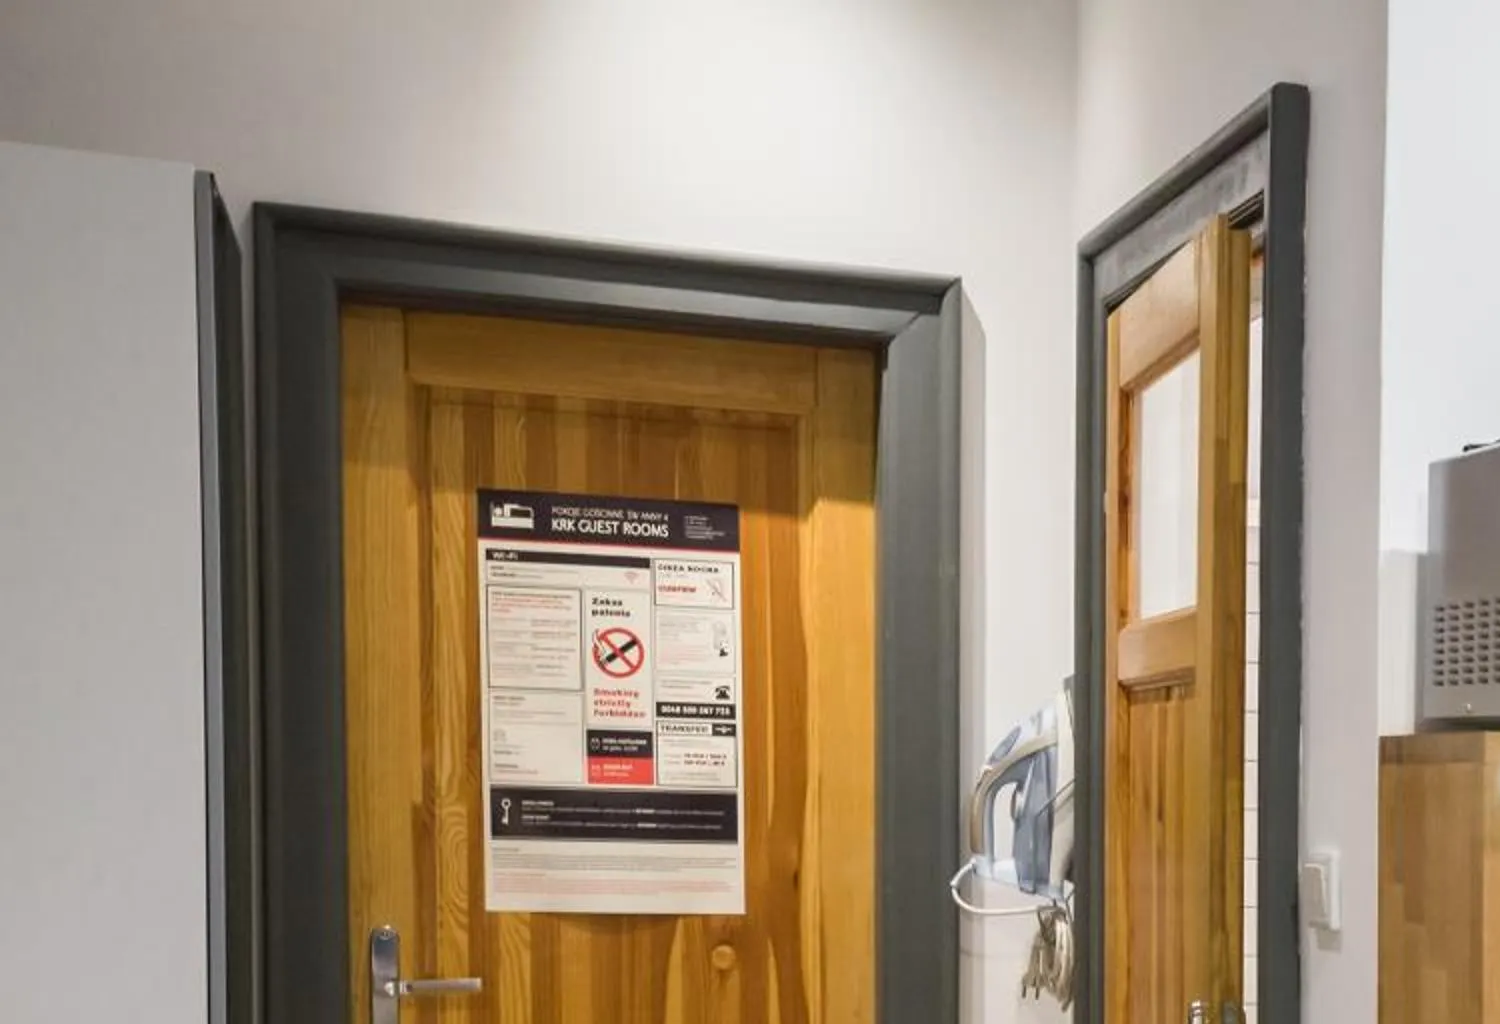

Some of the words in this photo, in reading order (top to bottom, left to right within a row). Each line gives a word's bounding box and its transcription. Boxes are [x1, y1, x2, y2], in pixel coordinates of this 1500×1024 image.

[551, 518, 576, 532] KRK
[578, 519, 620, 535] GUEST
[622, 521, 670, 538] ROOMS
